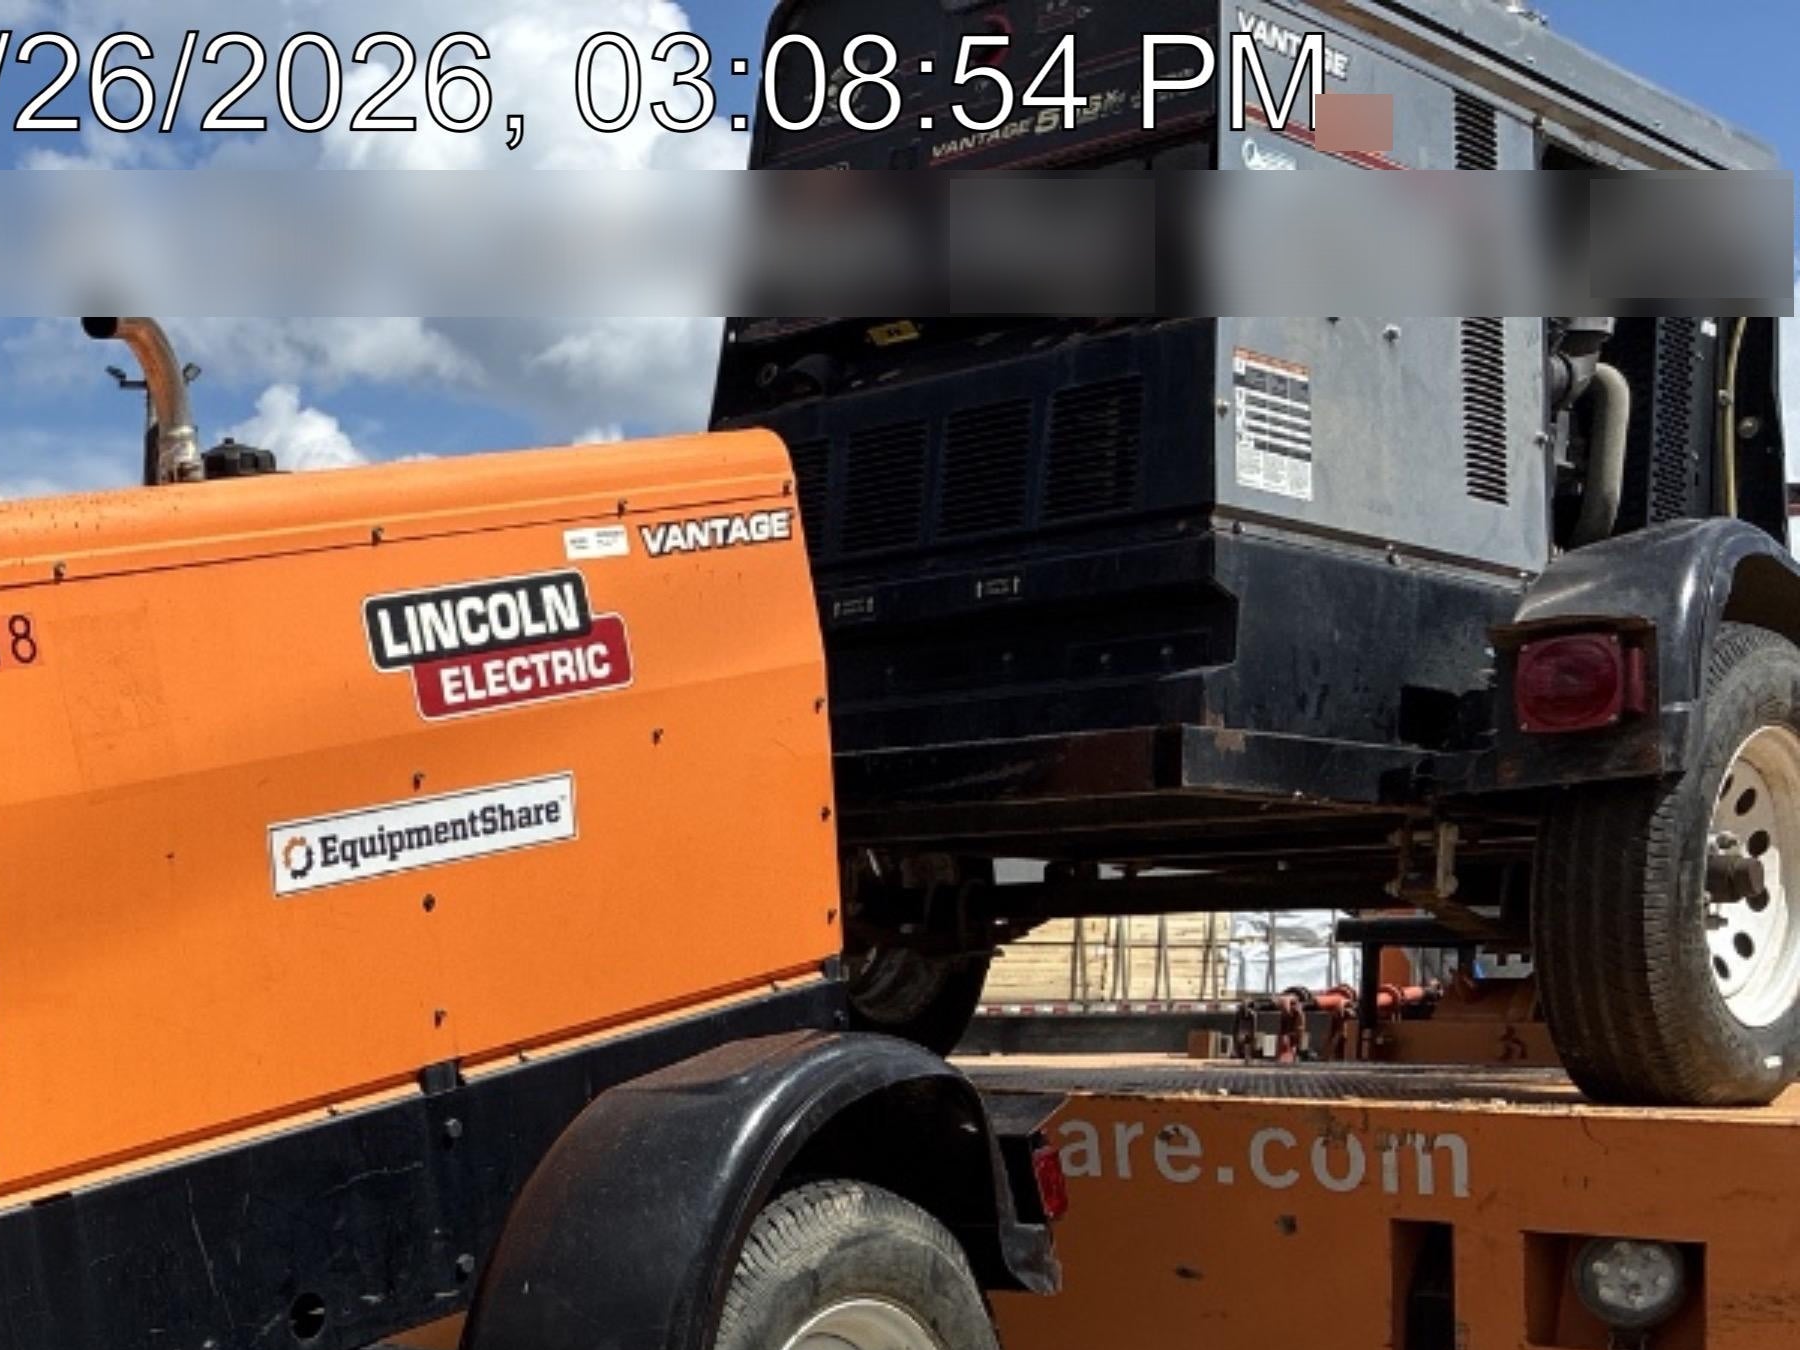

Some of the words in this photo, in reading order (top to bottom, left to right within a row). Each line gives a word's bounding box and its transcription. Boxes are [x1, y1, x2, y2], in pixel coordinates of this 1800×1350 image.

[1236, 8, 1349, 81] VANTGE
[638, 509, 792, 556] VANTAGE
[377, 582, 581, 658] LINCOLN
[440, 643, 612, 704] ELECTRIC
[319, 800, 561, 870] EquipmentShare
[1058, 1118, 1471, 1198] are.com
